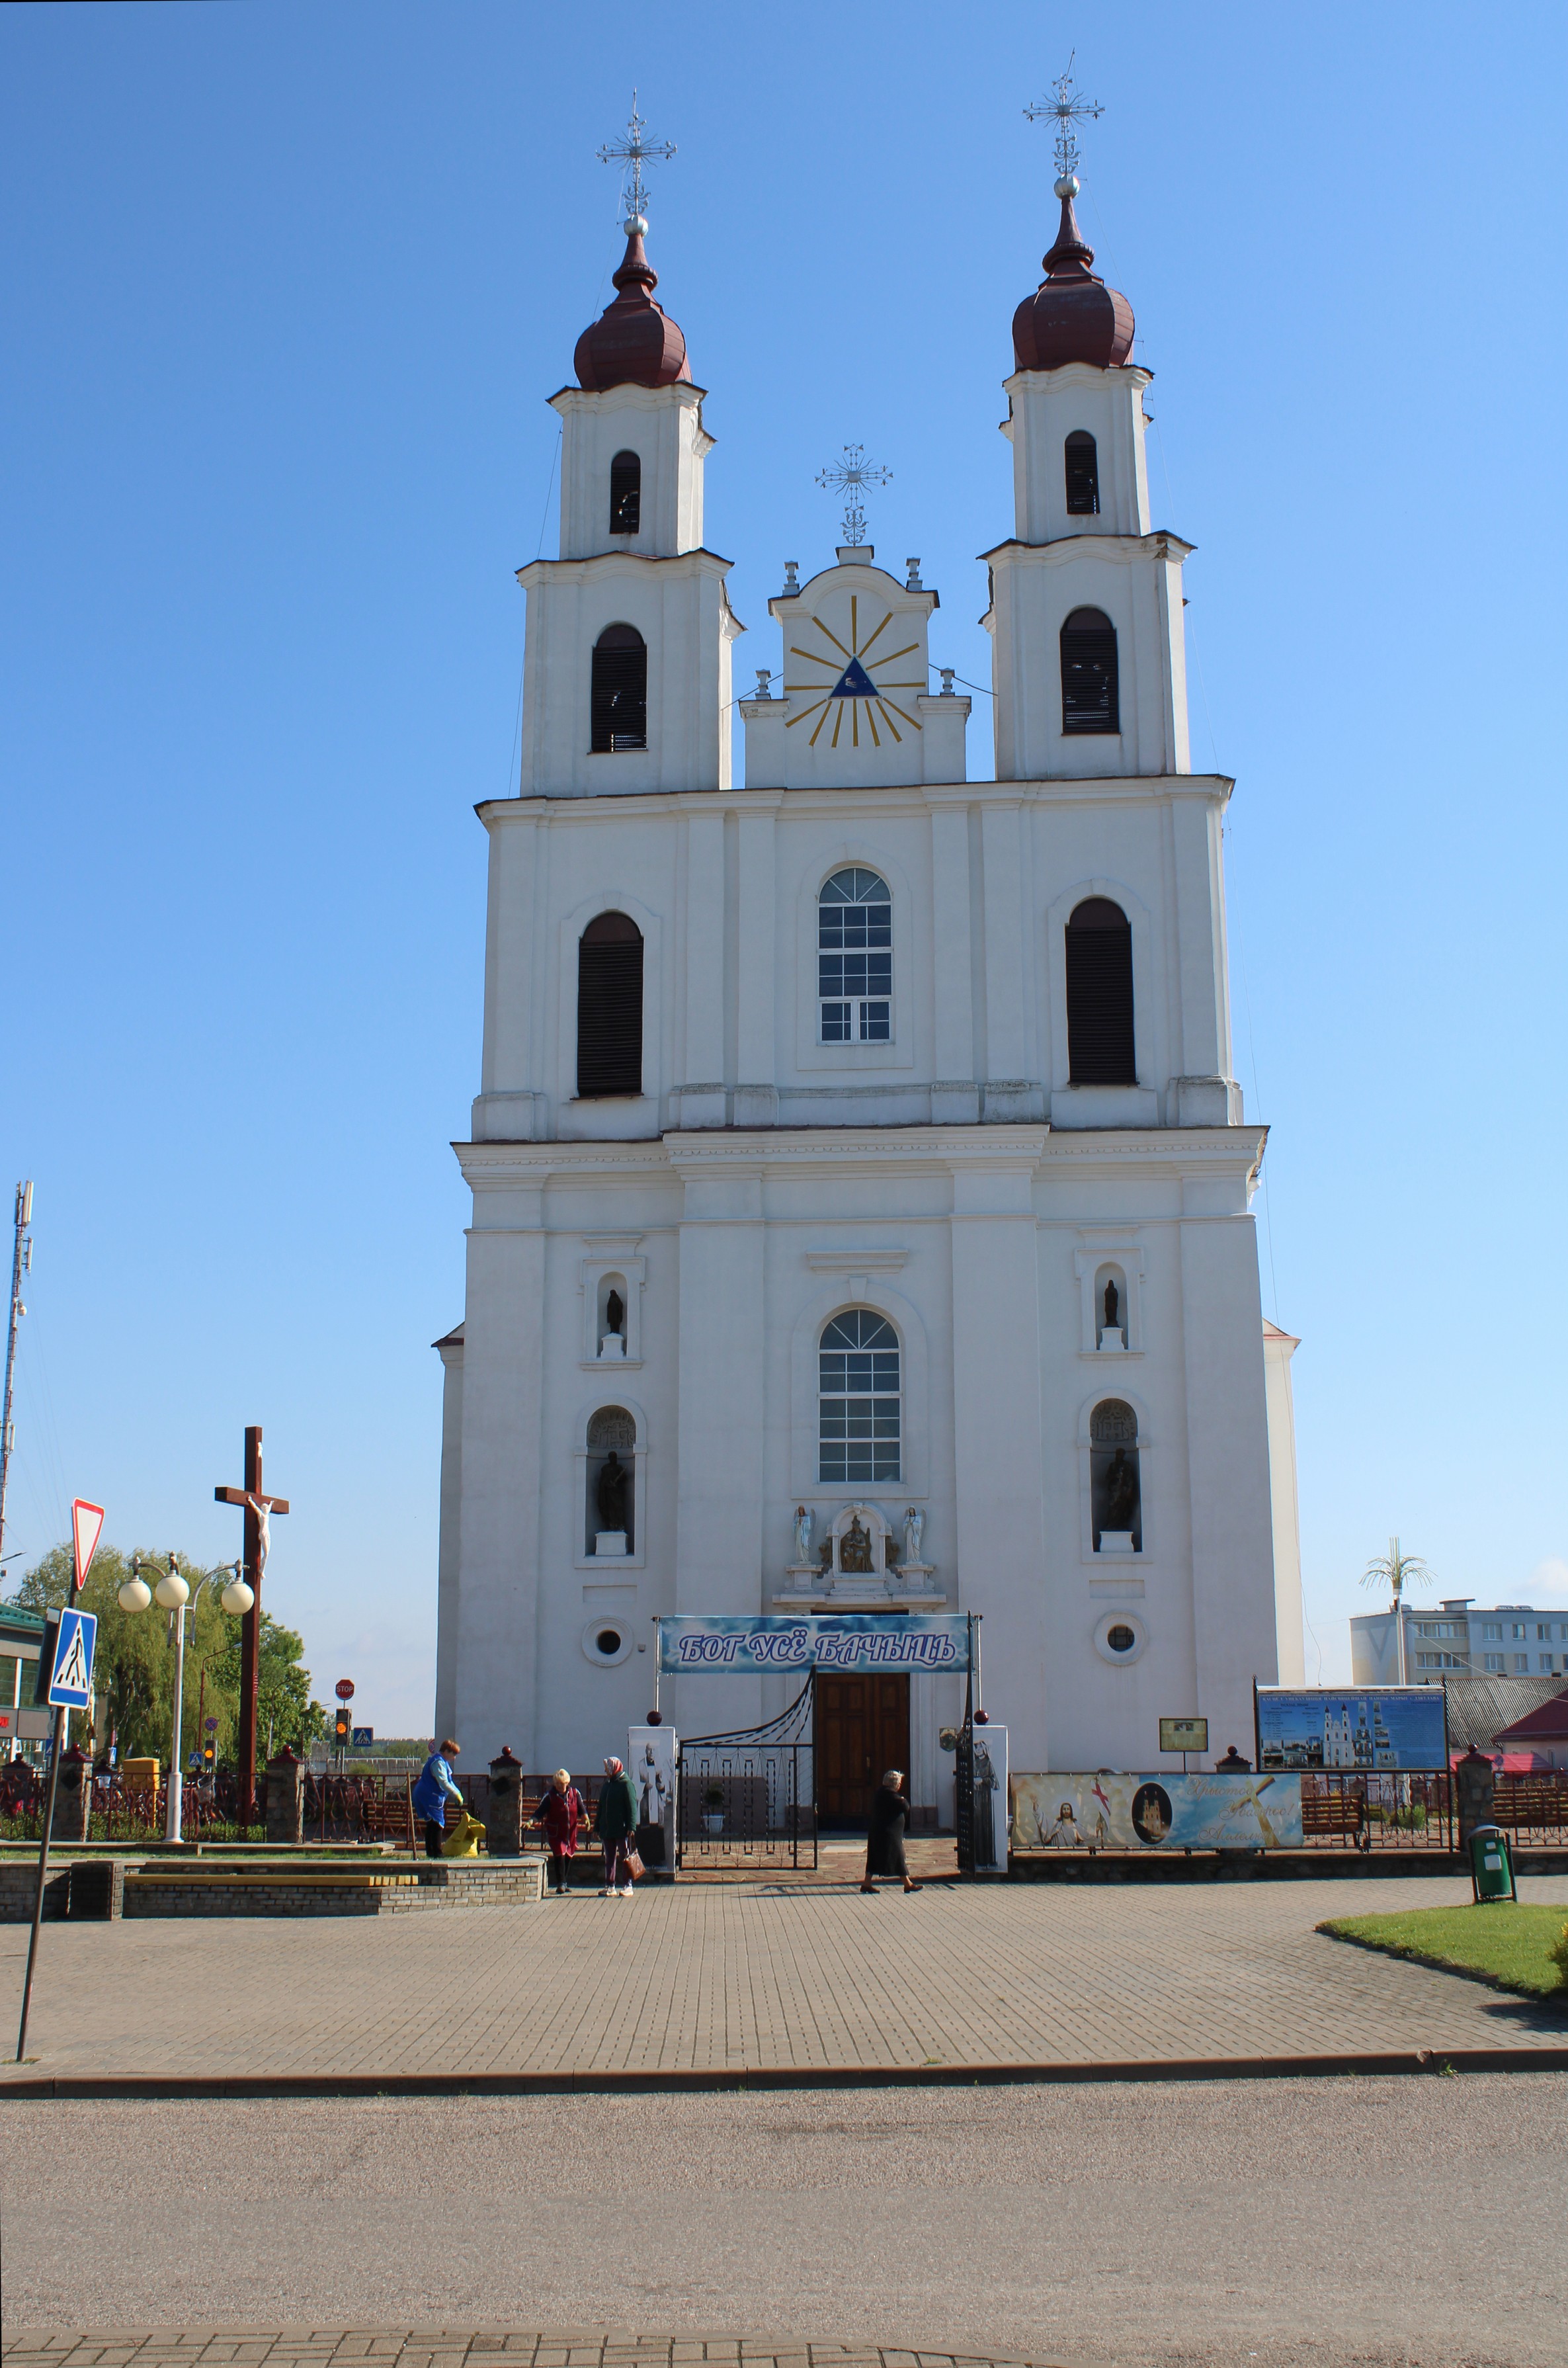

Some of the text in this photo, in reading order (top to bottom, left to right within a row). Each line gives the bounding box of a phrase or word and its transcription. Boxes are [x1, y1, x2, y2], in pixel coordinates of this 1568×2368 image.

[679, 1629, 956, 1666] БОГ УСЁ БАЧЫЦЬ
[1187, 1777, 1253, 1800] Хрыстос
